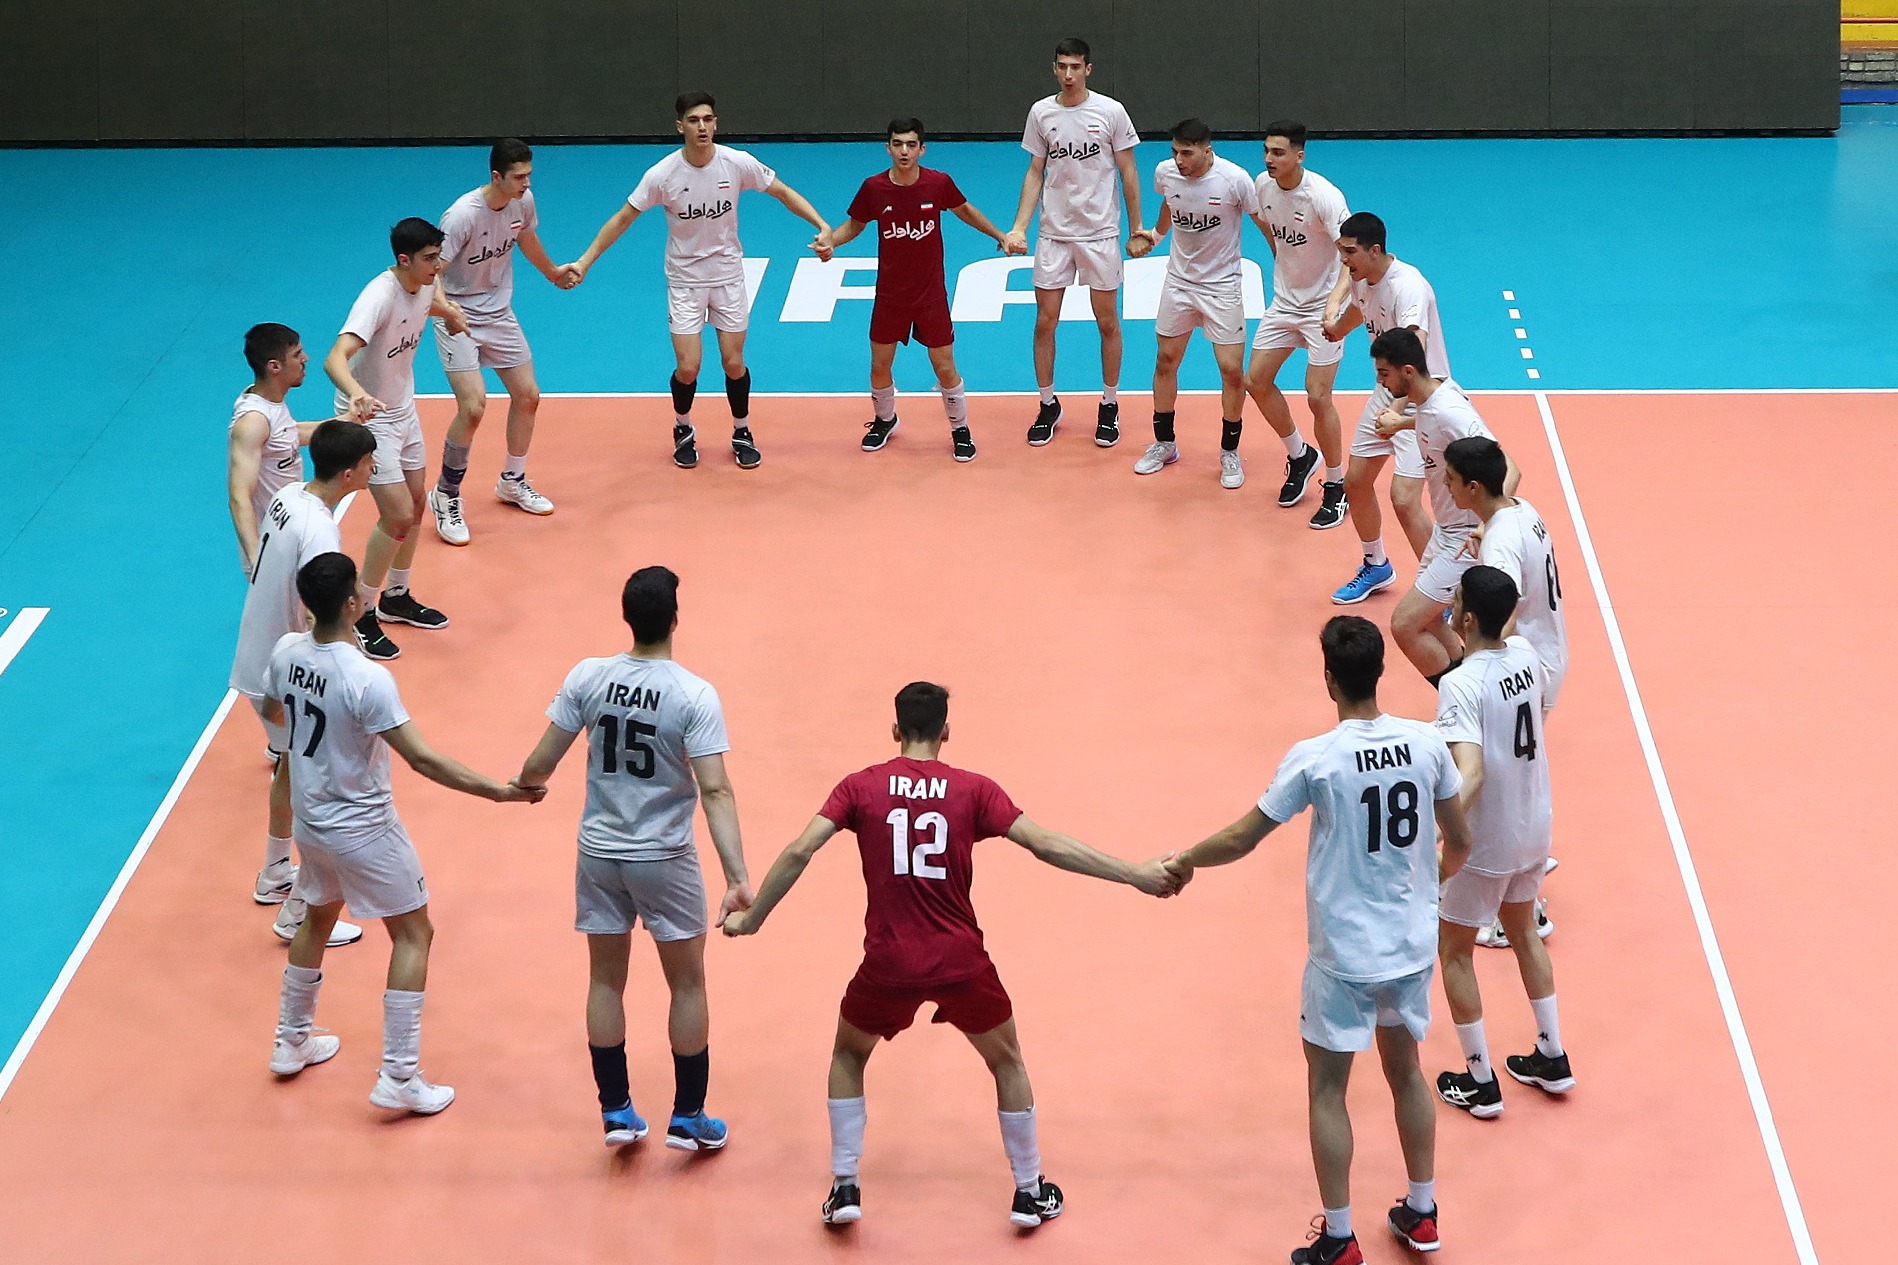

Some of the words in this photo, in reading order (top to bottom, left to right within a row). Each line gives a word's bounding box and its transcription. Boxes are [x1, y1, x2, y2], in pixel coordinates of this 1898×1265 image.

[288, 663, 327, 698] IRAN
[605, 682, 661, 712] IRAN
[1499, 666, 1535, 701] IRAN
[284, 693, 326, 758] 17
[598, 714, 657, 779] 15
[1514, 701, 1536, 762] 4
[1355, 743, 1412, 773] IRAN
[889, 775, 948, 800] IRAN
[1360, 780, 1418, 854] 18
[886, 807, 949, 880] 12
